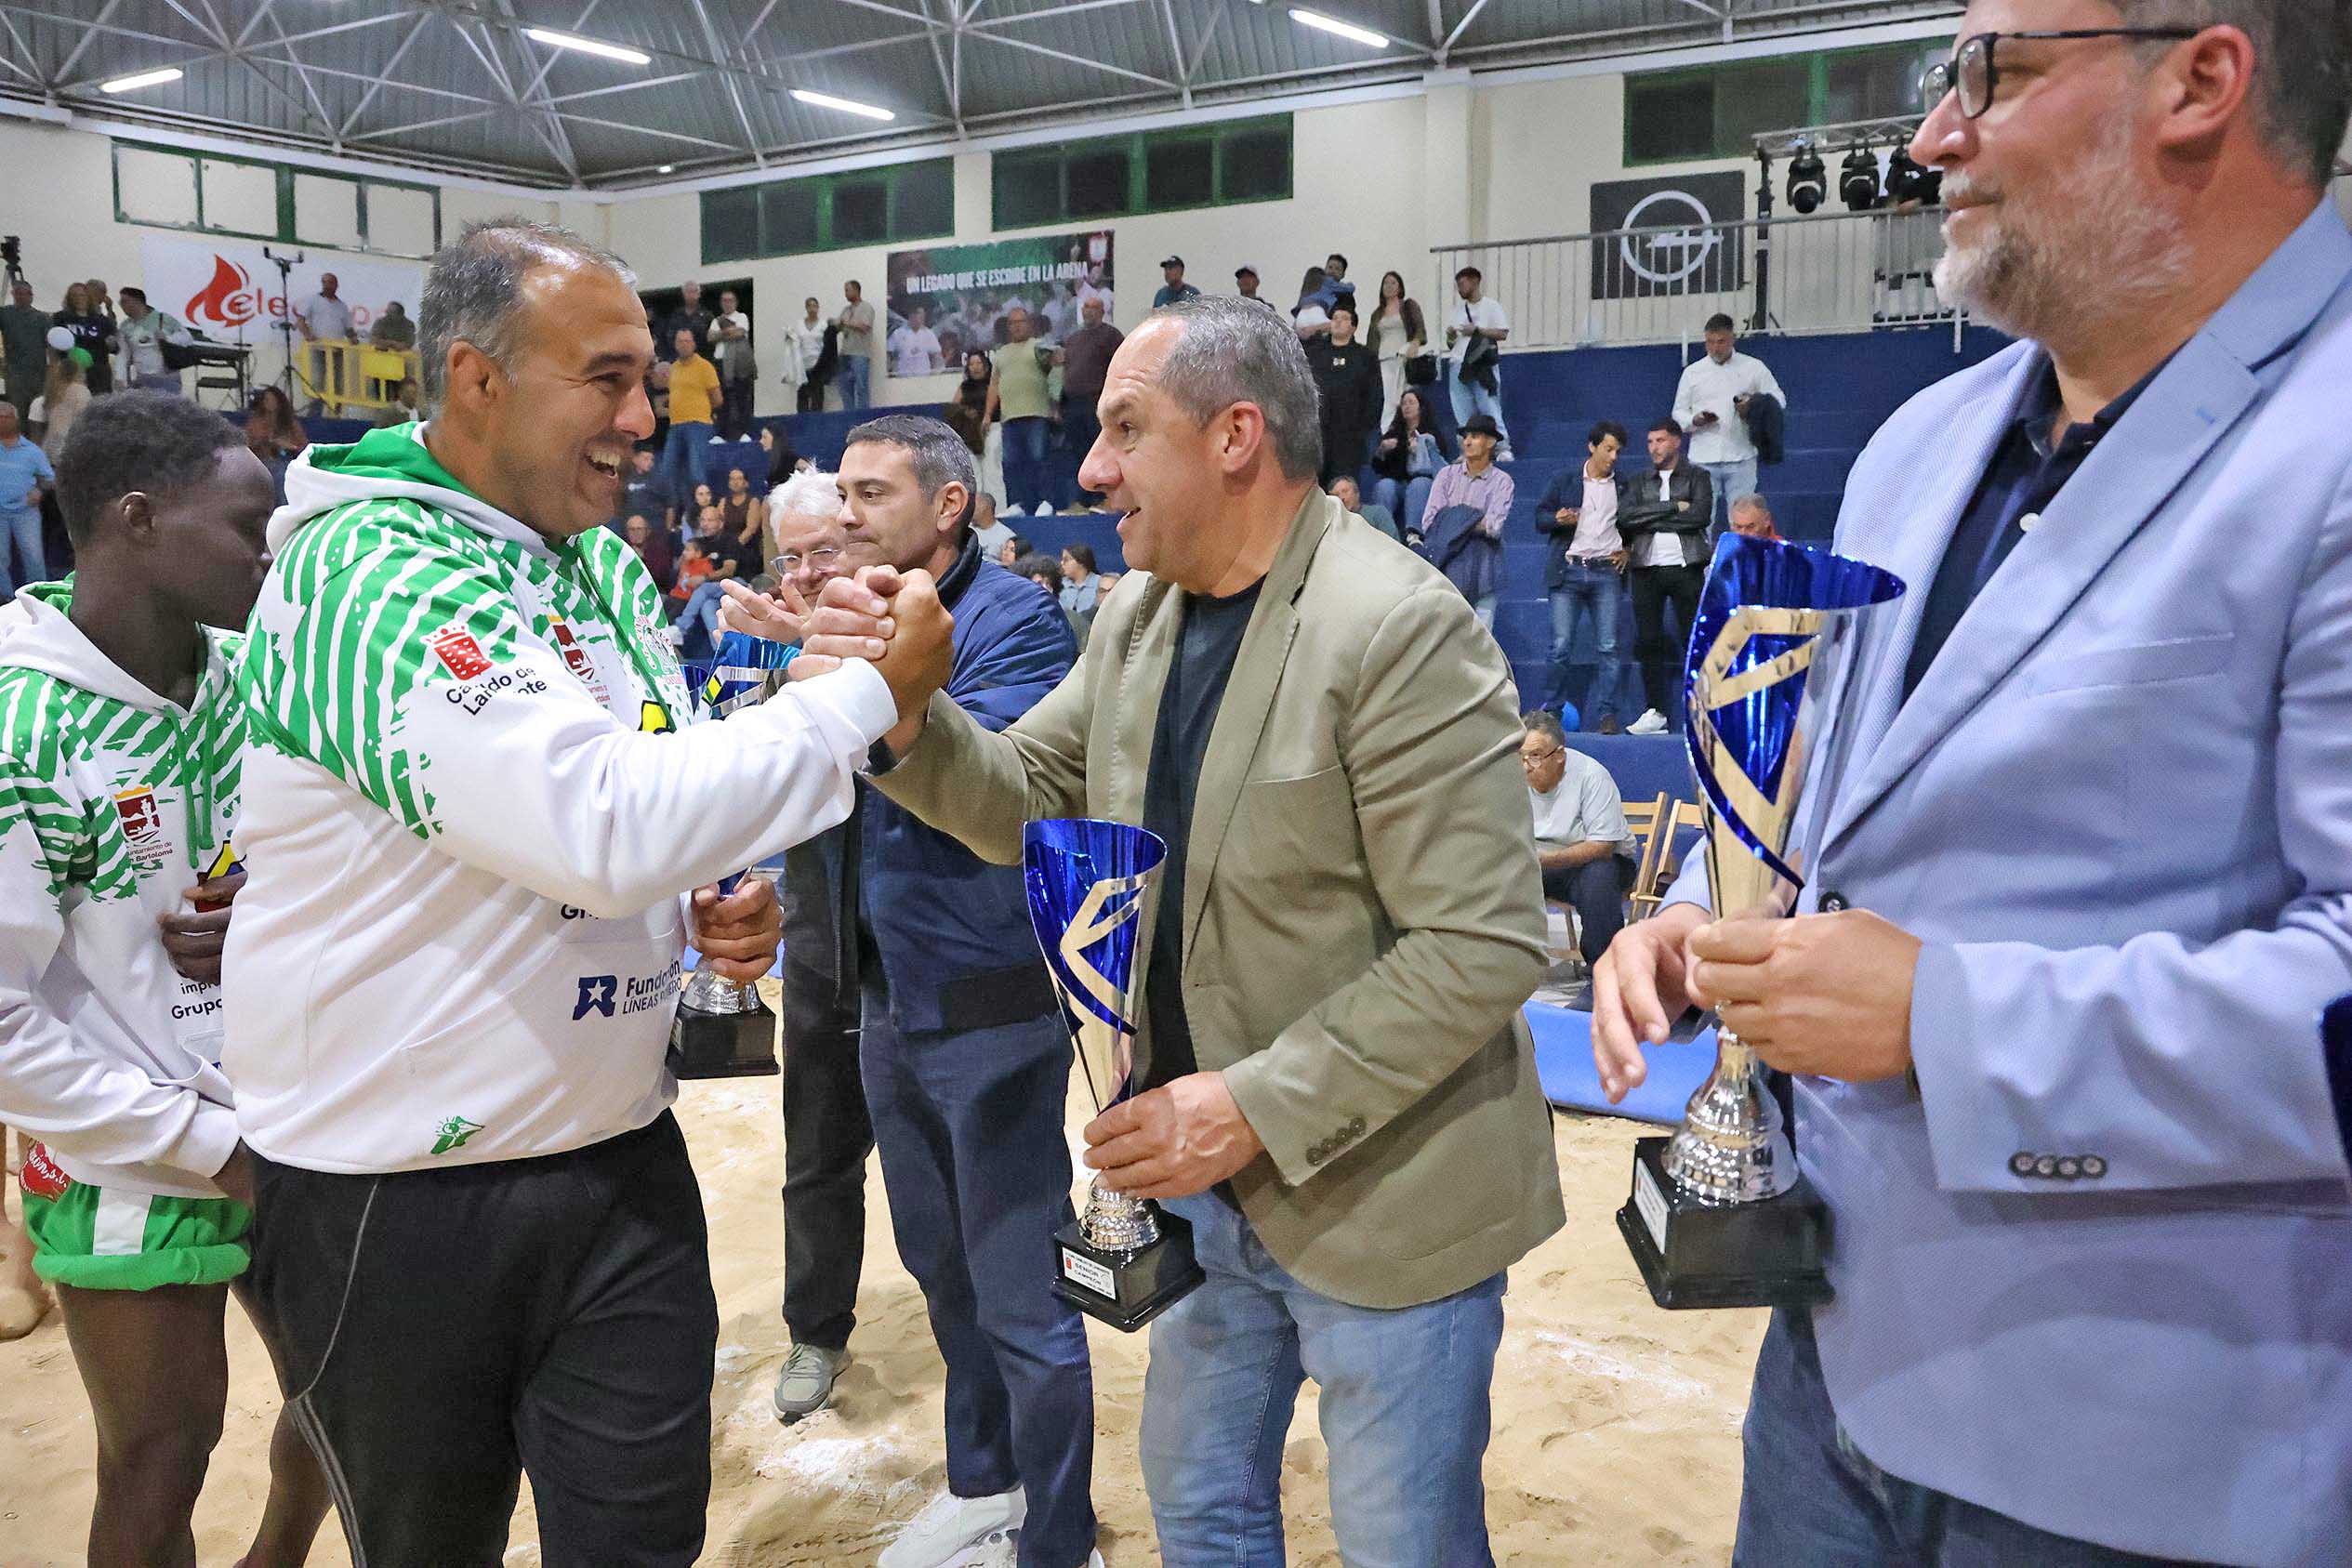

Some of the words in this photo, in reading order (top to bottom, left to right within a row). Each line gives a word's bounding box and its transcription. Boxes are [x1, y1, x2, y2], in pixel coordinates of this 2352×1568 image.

[920, 273, 956, 294] LEGADO
[957, 271, 975, 291] QUE
[976, 270, 987, 288] SE
[988, 266, 1026, 287] ESCRIBE
[1028, 264, 1041, 283] EN
[1042, 263, 1054, 282] LA
[1055, 260, 1089, 281] ARENA
